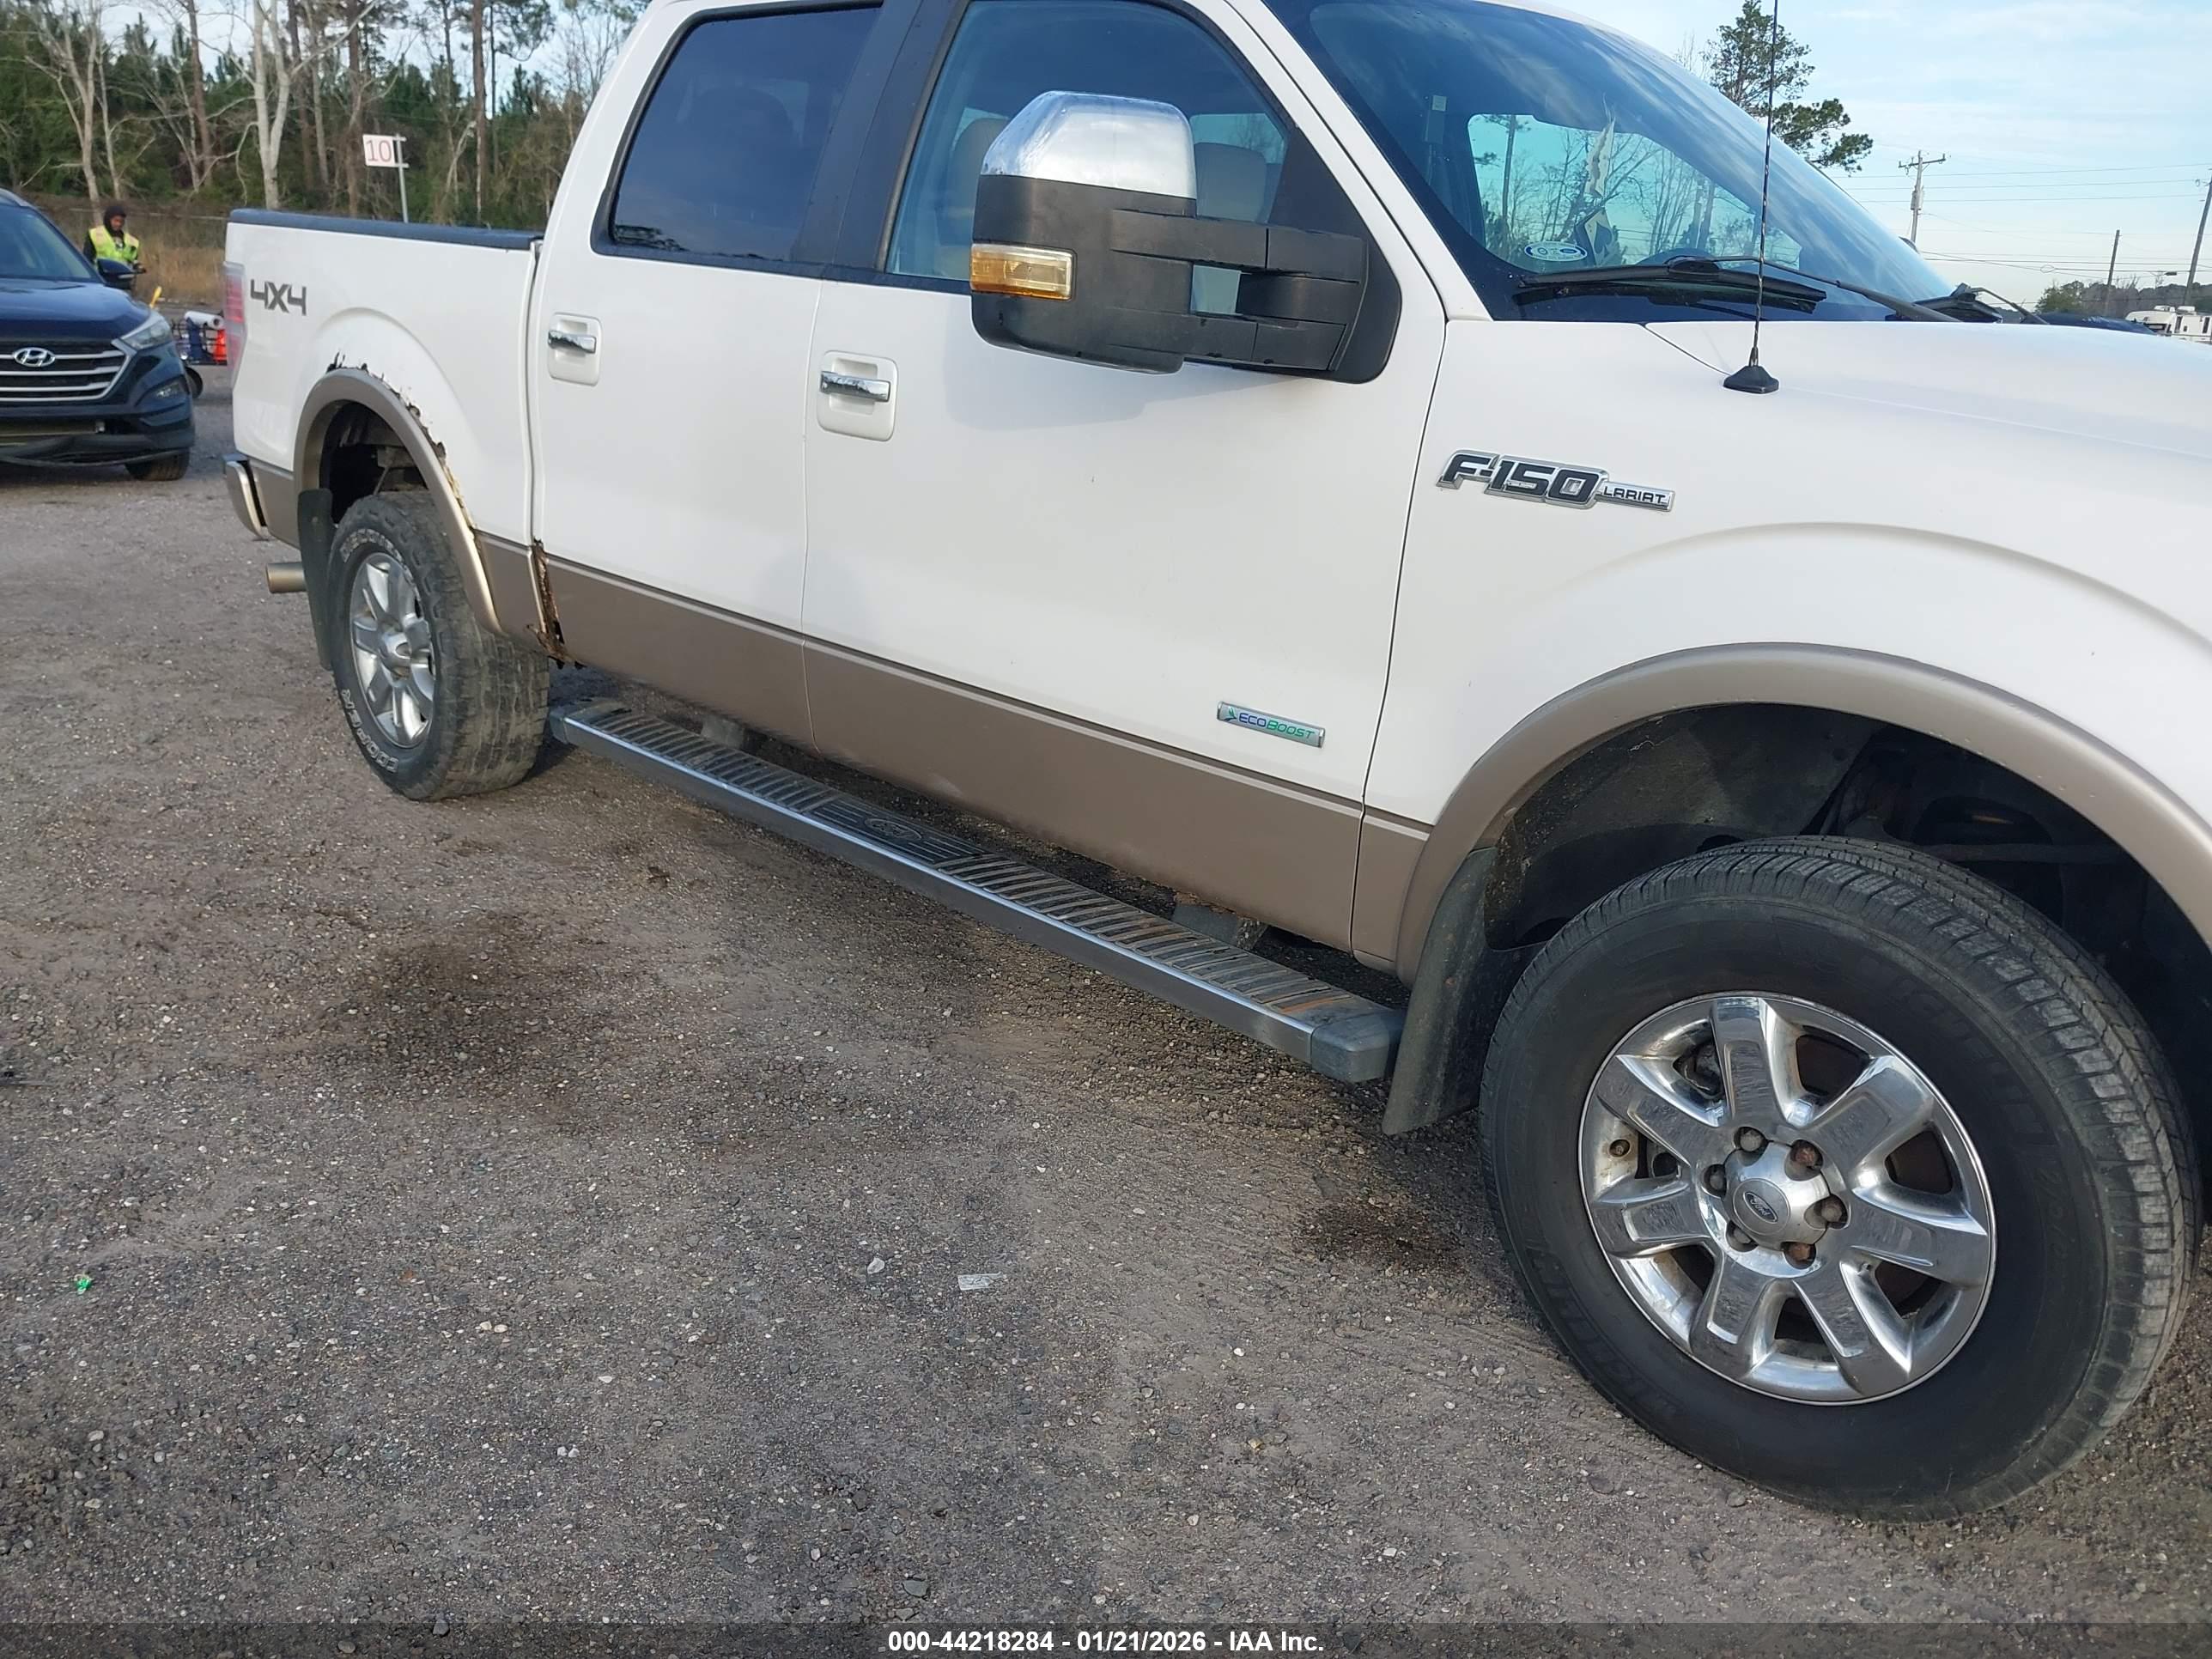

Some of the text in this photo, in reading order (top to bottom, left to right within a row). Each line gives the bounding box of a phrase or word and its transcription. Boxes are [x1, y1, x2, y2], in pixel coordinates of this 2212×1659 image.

[365, 139, 392, 162] 10
[1439, 452, 1668, 507] F-150 LARIAT
[341, 689, 399, 773] COOPER
